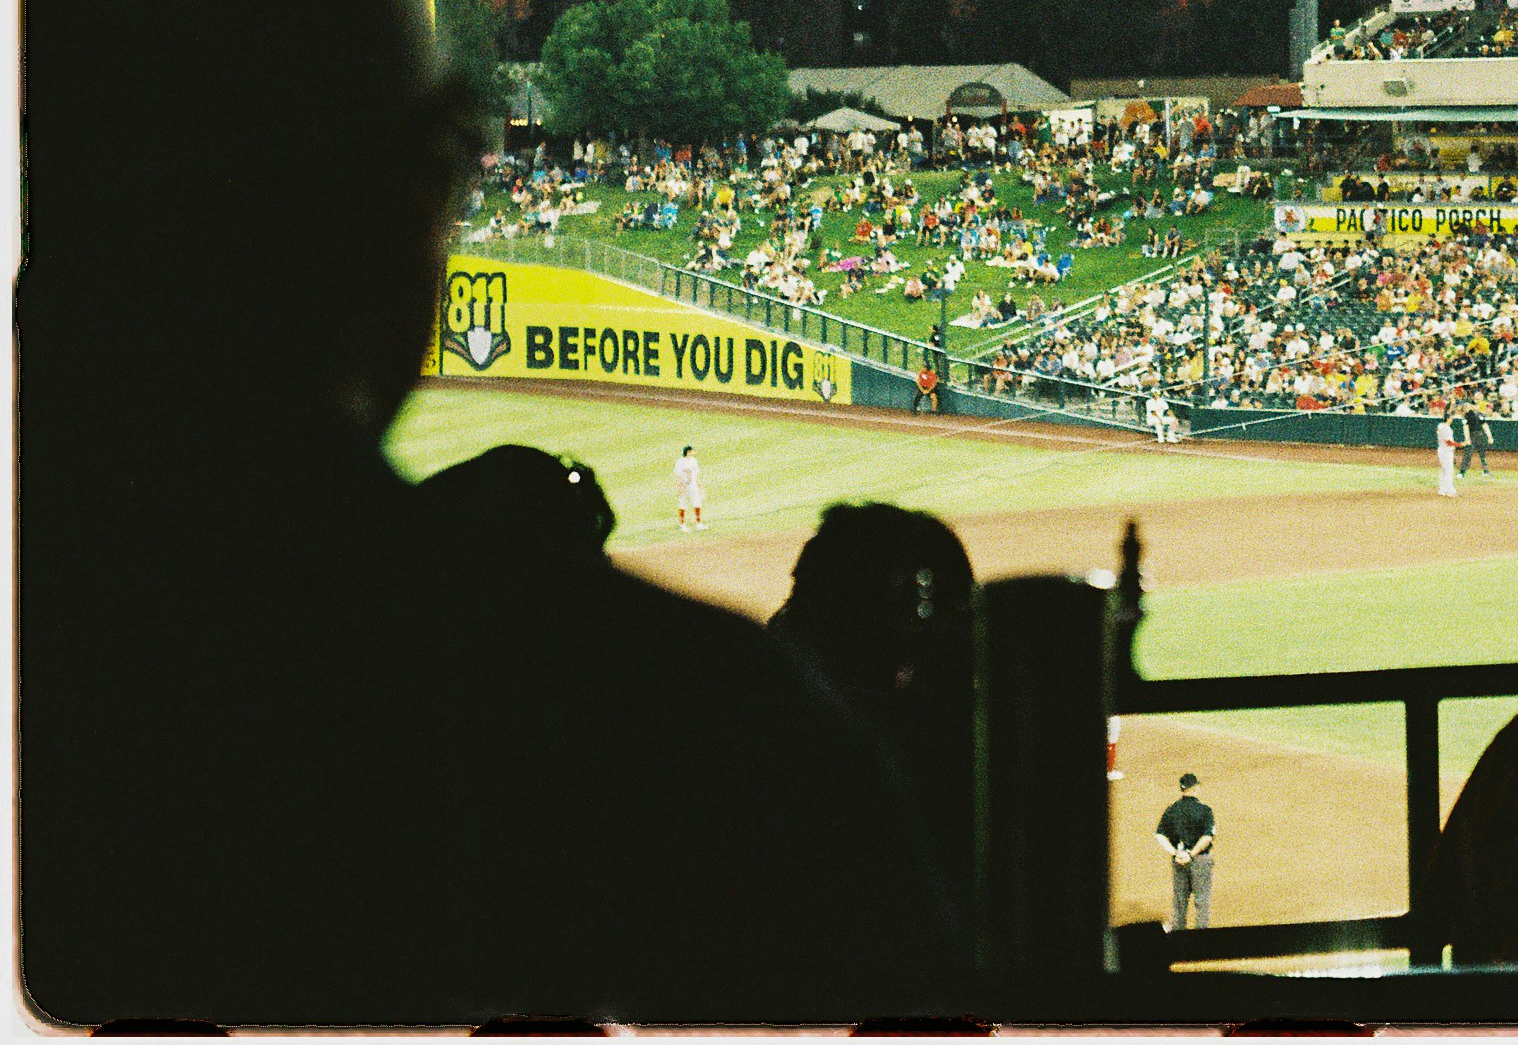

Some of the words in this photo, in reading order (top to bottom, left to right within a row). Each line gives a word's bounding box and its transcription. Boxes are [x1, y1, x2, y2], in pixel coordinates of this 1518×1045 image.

[1436, 208, 1501, 233] PORCH
[446, 271, 507, 334] 811
[525, 325, 661, 377] BEFORE
[669, 332, 735, 384] YOU
[745, 338, 804, 390] DIG
